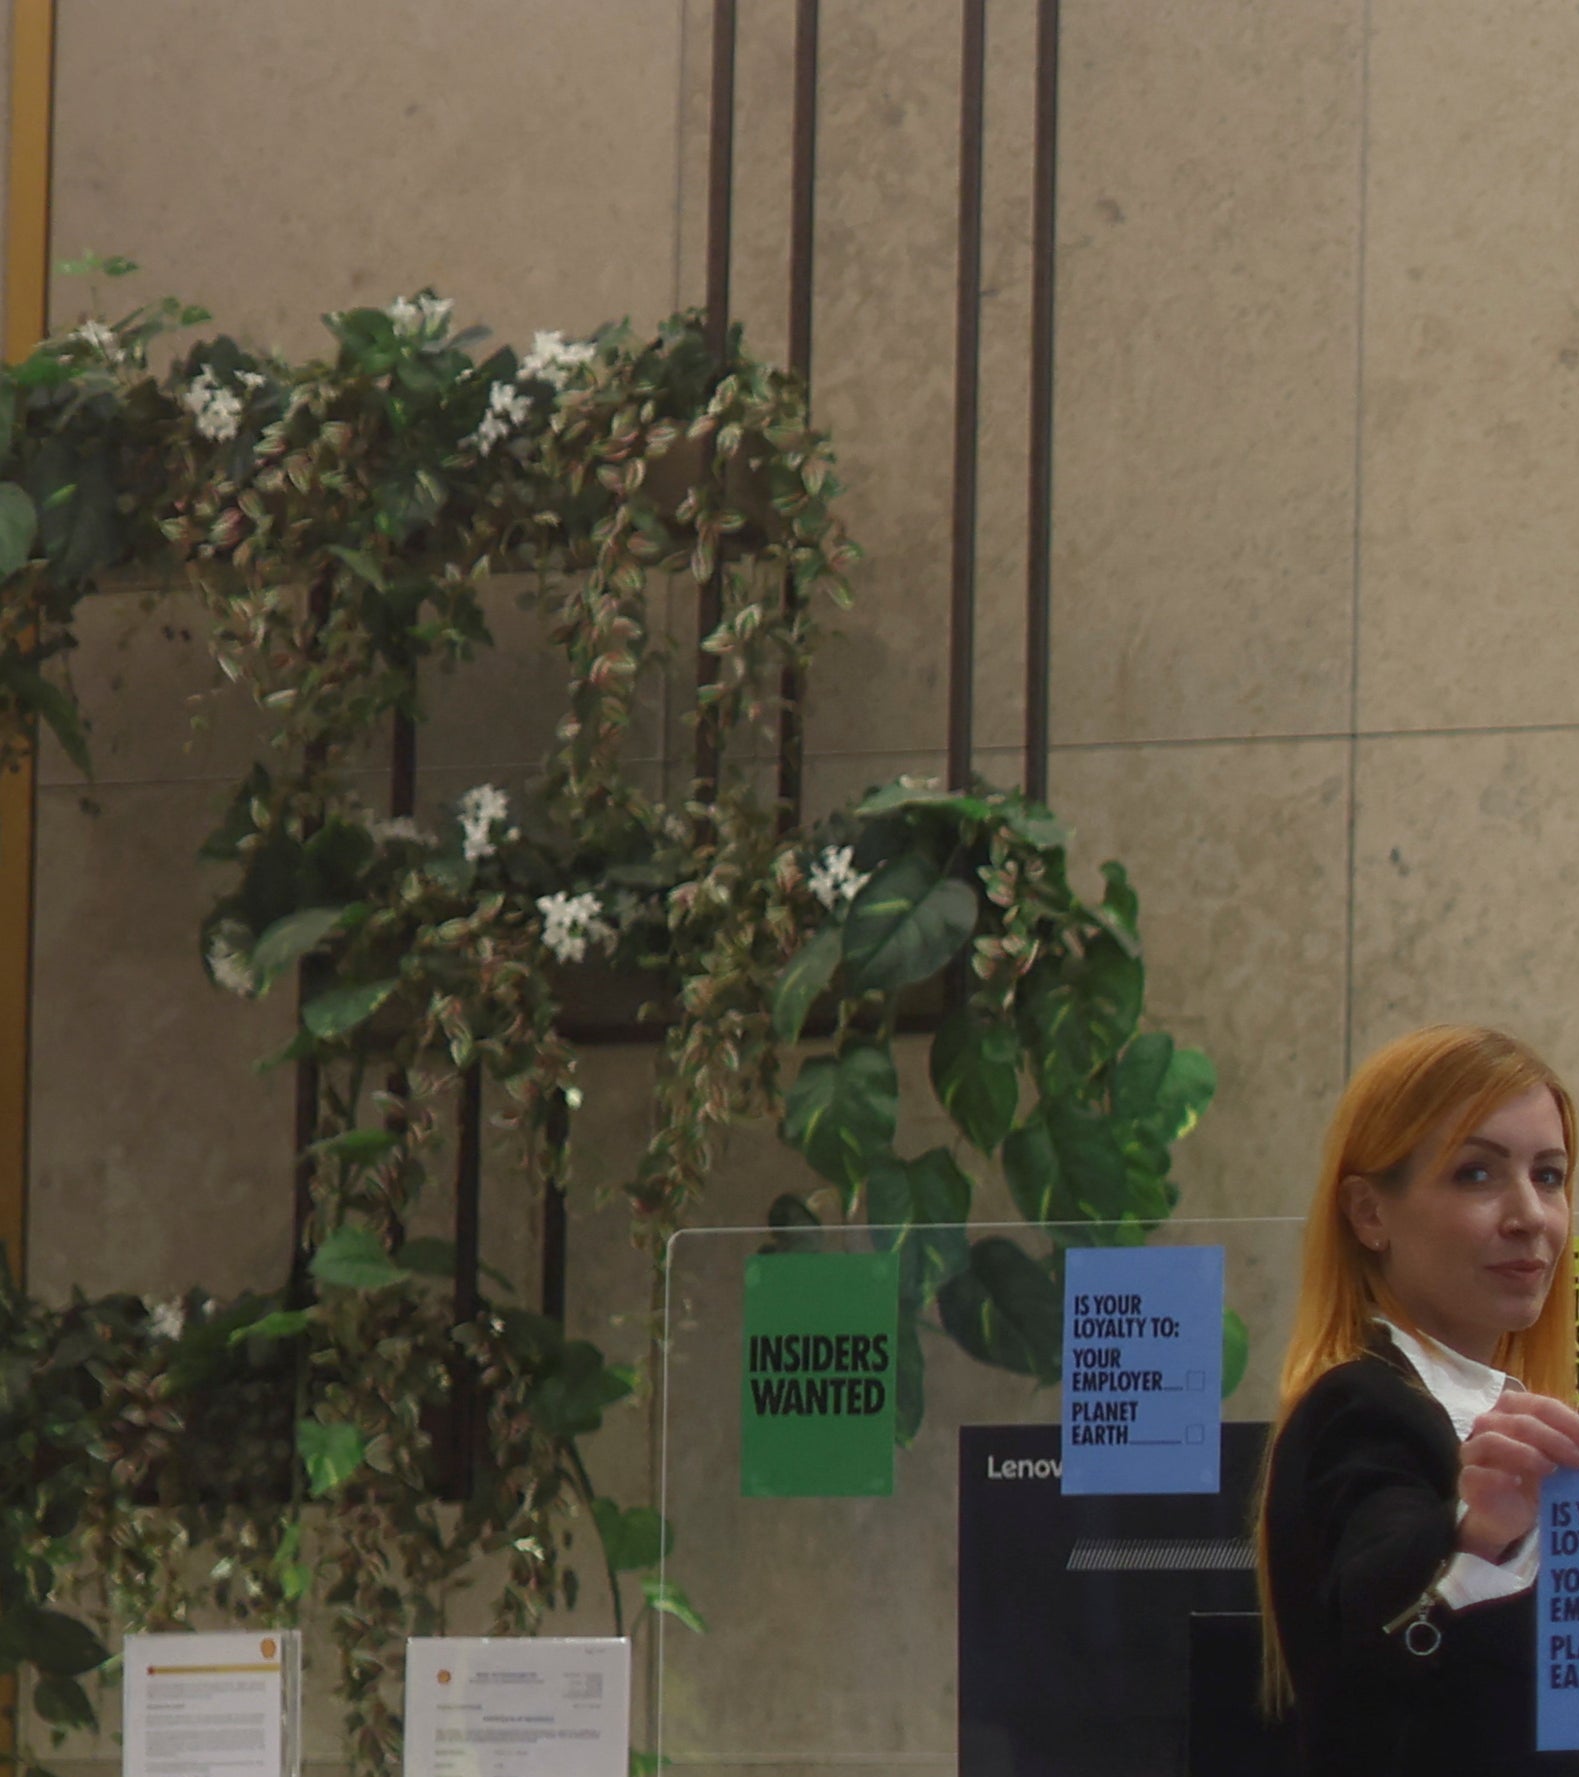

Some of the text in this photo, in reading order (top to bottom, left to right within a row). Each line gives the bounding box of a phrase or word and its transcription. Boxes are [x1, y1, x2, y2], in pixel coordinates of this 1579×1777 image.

[1074, 1295, 1142, 1315] IS YOUR
[1074, 1317, 1180, 1338] LOYALTY TO:
[750, 1335, 889, 1372] INSIDERS
[1073, 1349, 1121, 1368] YOUR
[751, 1379, 886, 1416] WANTED
[1072, 1402, 1138, 1422] PLANET
[988, 1455, 1063, 1479] Lenov
[1551, 1503, 1571, 1527] IS
